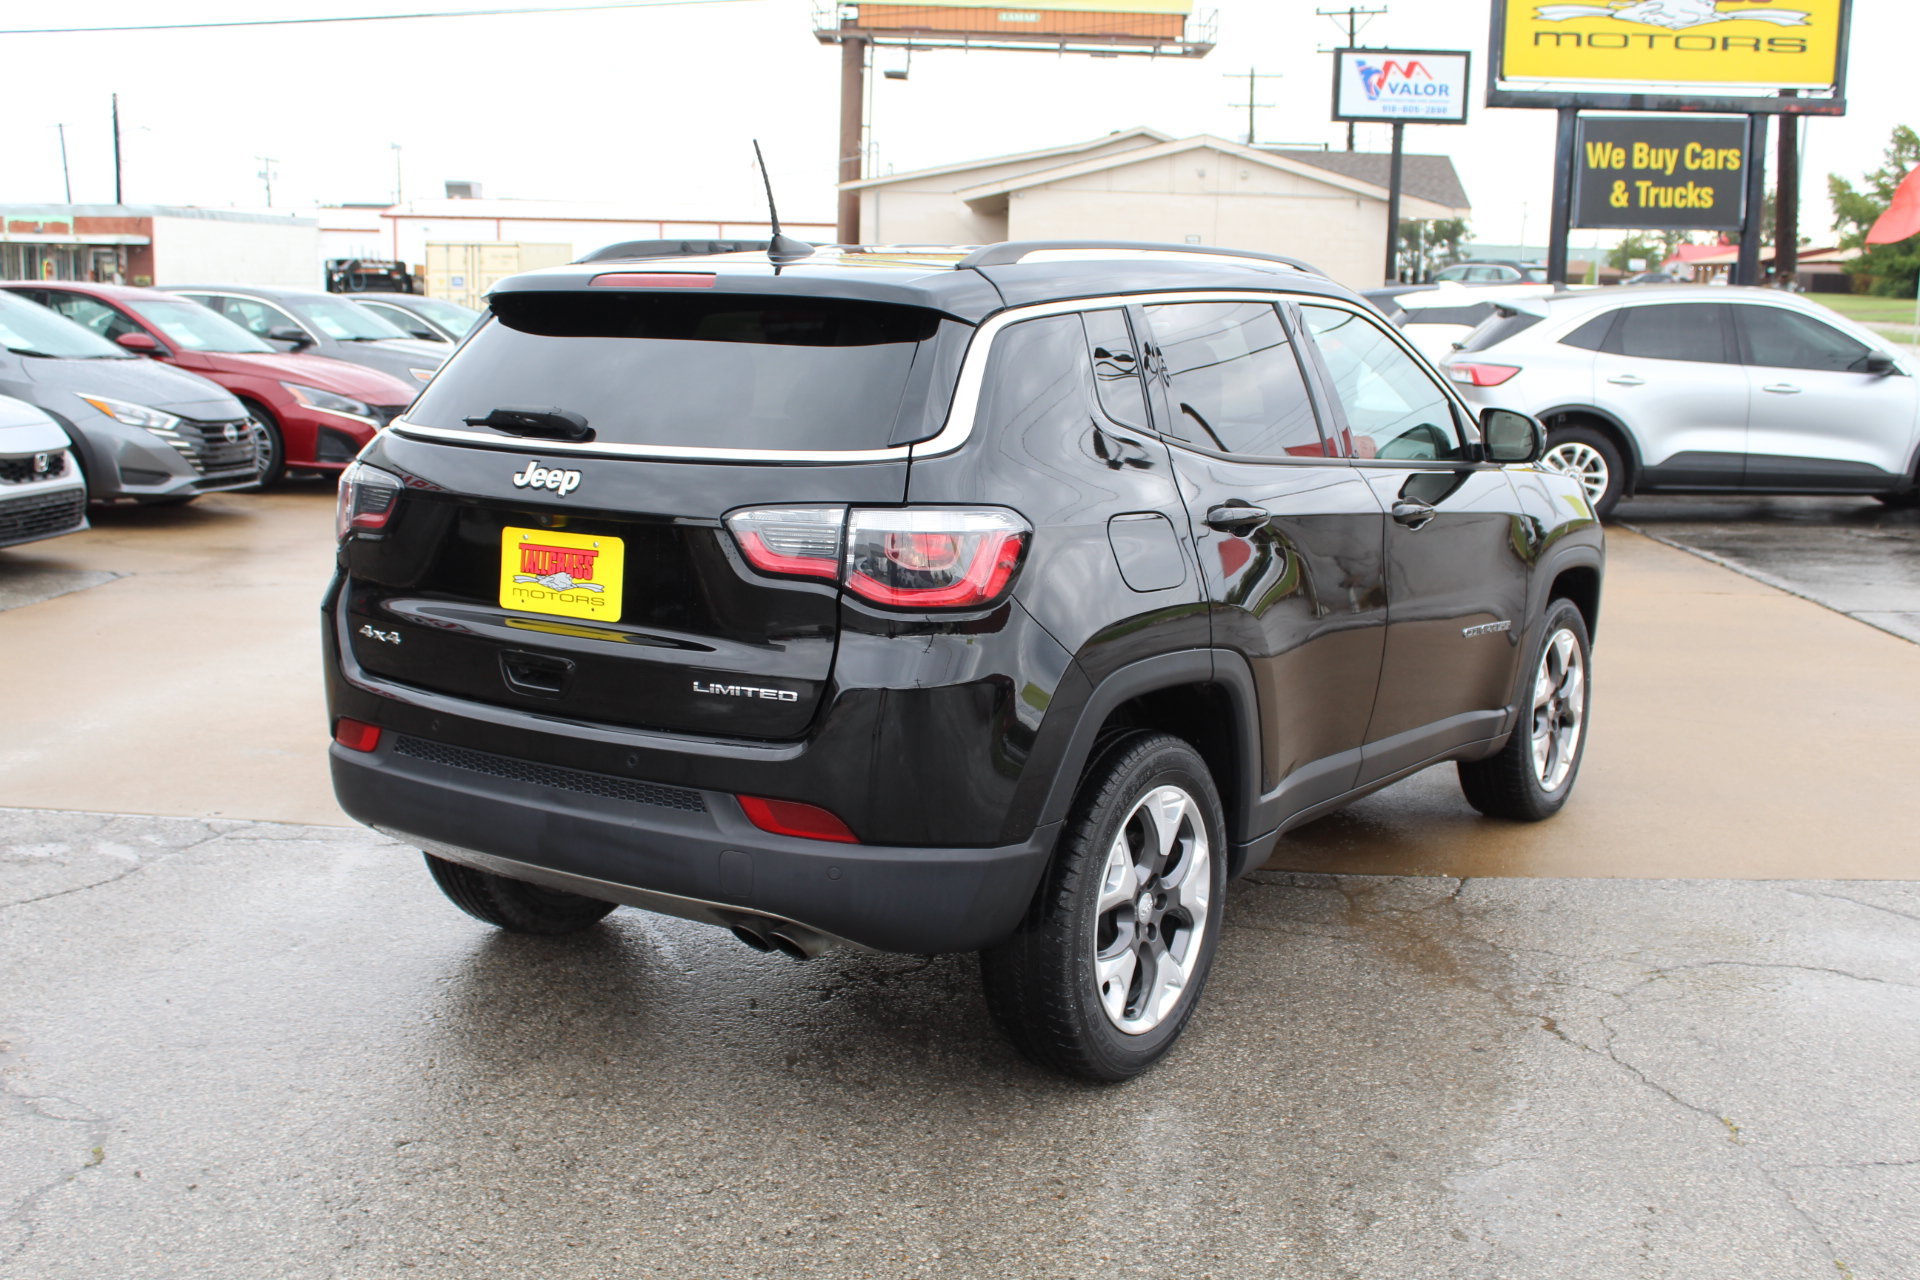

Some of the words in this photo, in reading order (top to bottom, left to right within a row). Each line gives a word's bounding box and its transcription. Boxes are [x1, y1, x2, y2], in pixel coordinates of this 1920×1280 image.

[1533, 31, 1807, 53] MOTORS
[1388, 82, 1450, 96] VALOR
[1586, 141, 1626, 169] We
[1632, 141, 1679, 176] Buy
[1684, 141, 1741, 171] Cars
[1609, 179, 1629, 208] &
[1635, 180, 1714, 208] Trucks
[512, 460, 583, 498] Jeep
[518, 542, 599, 581] TALLGRASS
[512, 587, 605, 607] MOTORS
[359, 624, 402, 645] 4x4
[693, 681, 798, 702] LIMITED
